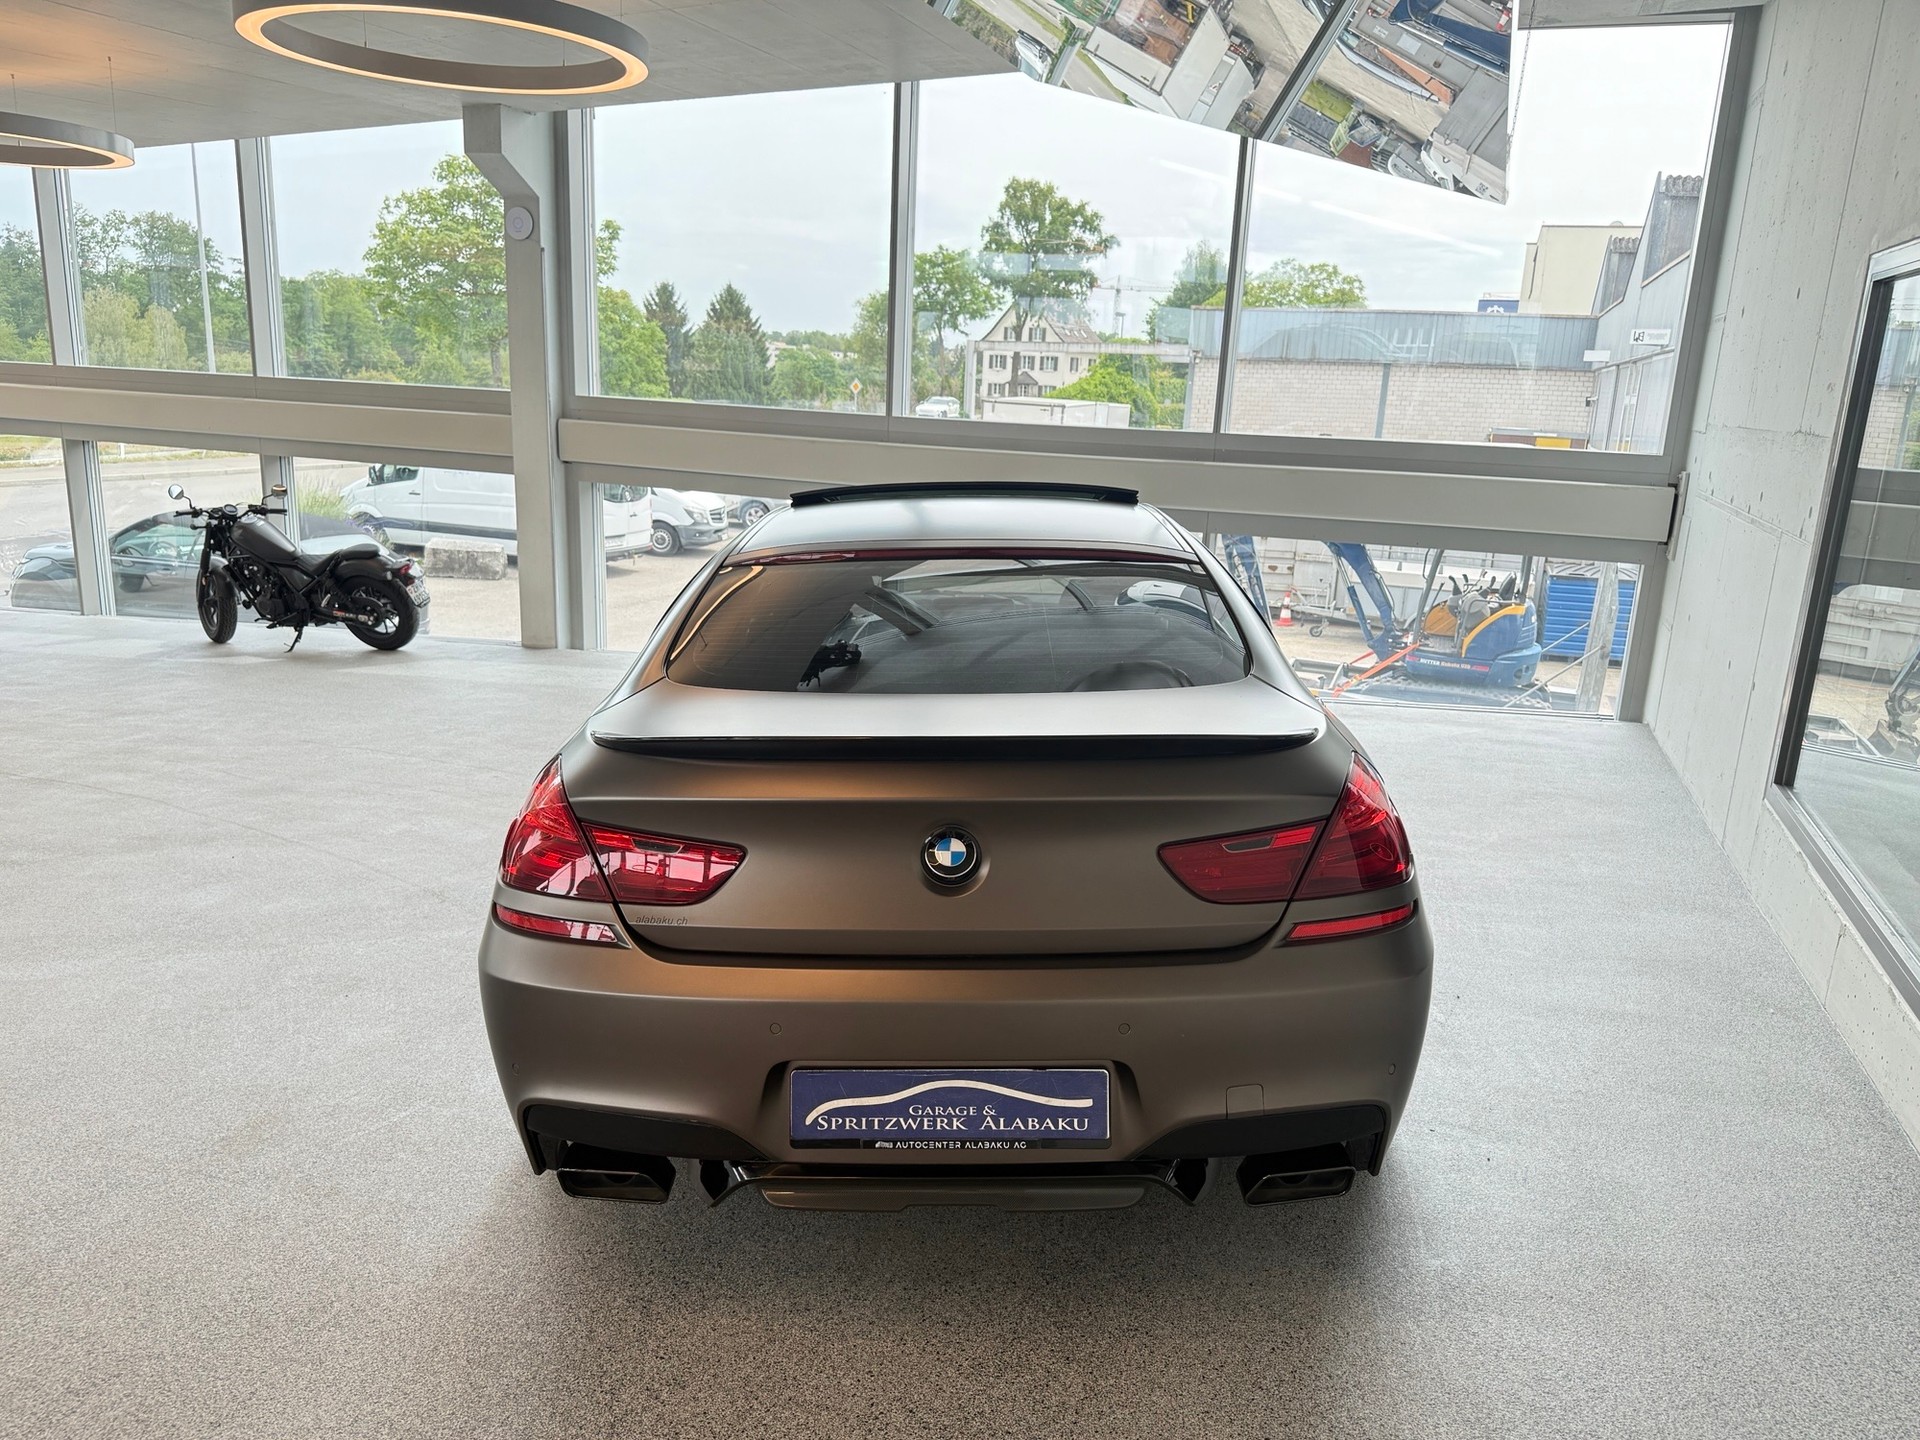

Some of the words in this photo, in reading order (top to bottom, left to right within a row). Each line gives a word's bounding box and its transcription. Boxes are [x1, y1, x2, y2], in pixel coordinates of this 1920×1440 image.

[635, 915, 689, 926] alabaku.ch
[908, 1104, 977, 1116] GARAGE
[982, 1104, 998, 1116] &
[817, 1115, 969, 1131] SPRITZWERK
[979, 1115, 1089, 1131] ALABAKU
[895, 1141, 961, 1149] AUTOCENTER
[964, 1141, 1010, 1149] ALABAKU
[1013, 1141, 1027, 1149] AG
